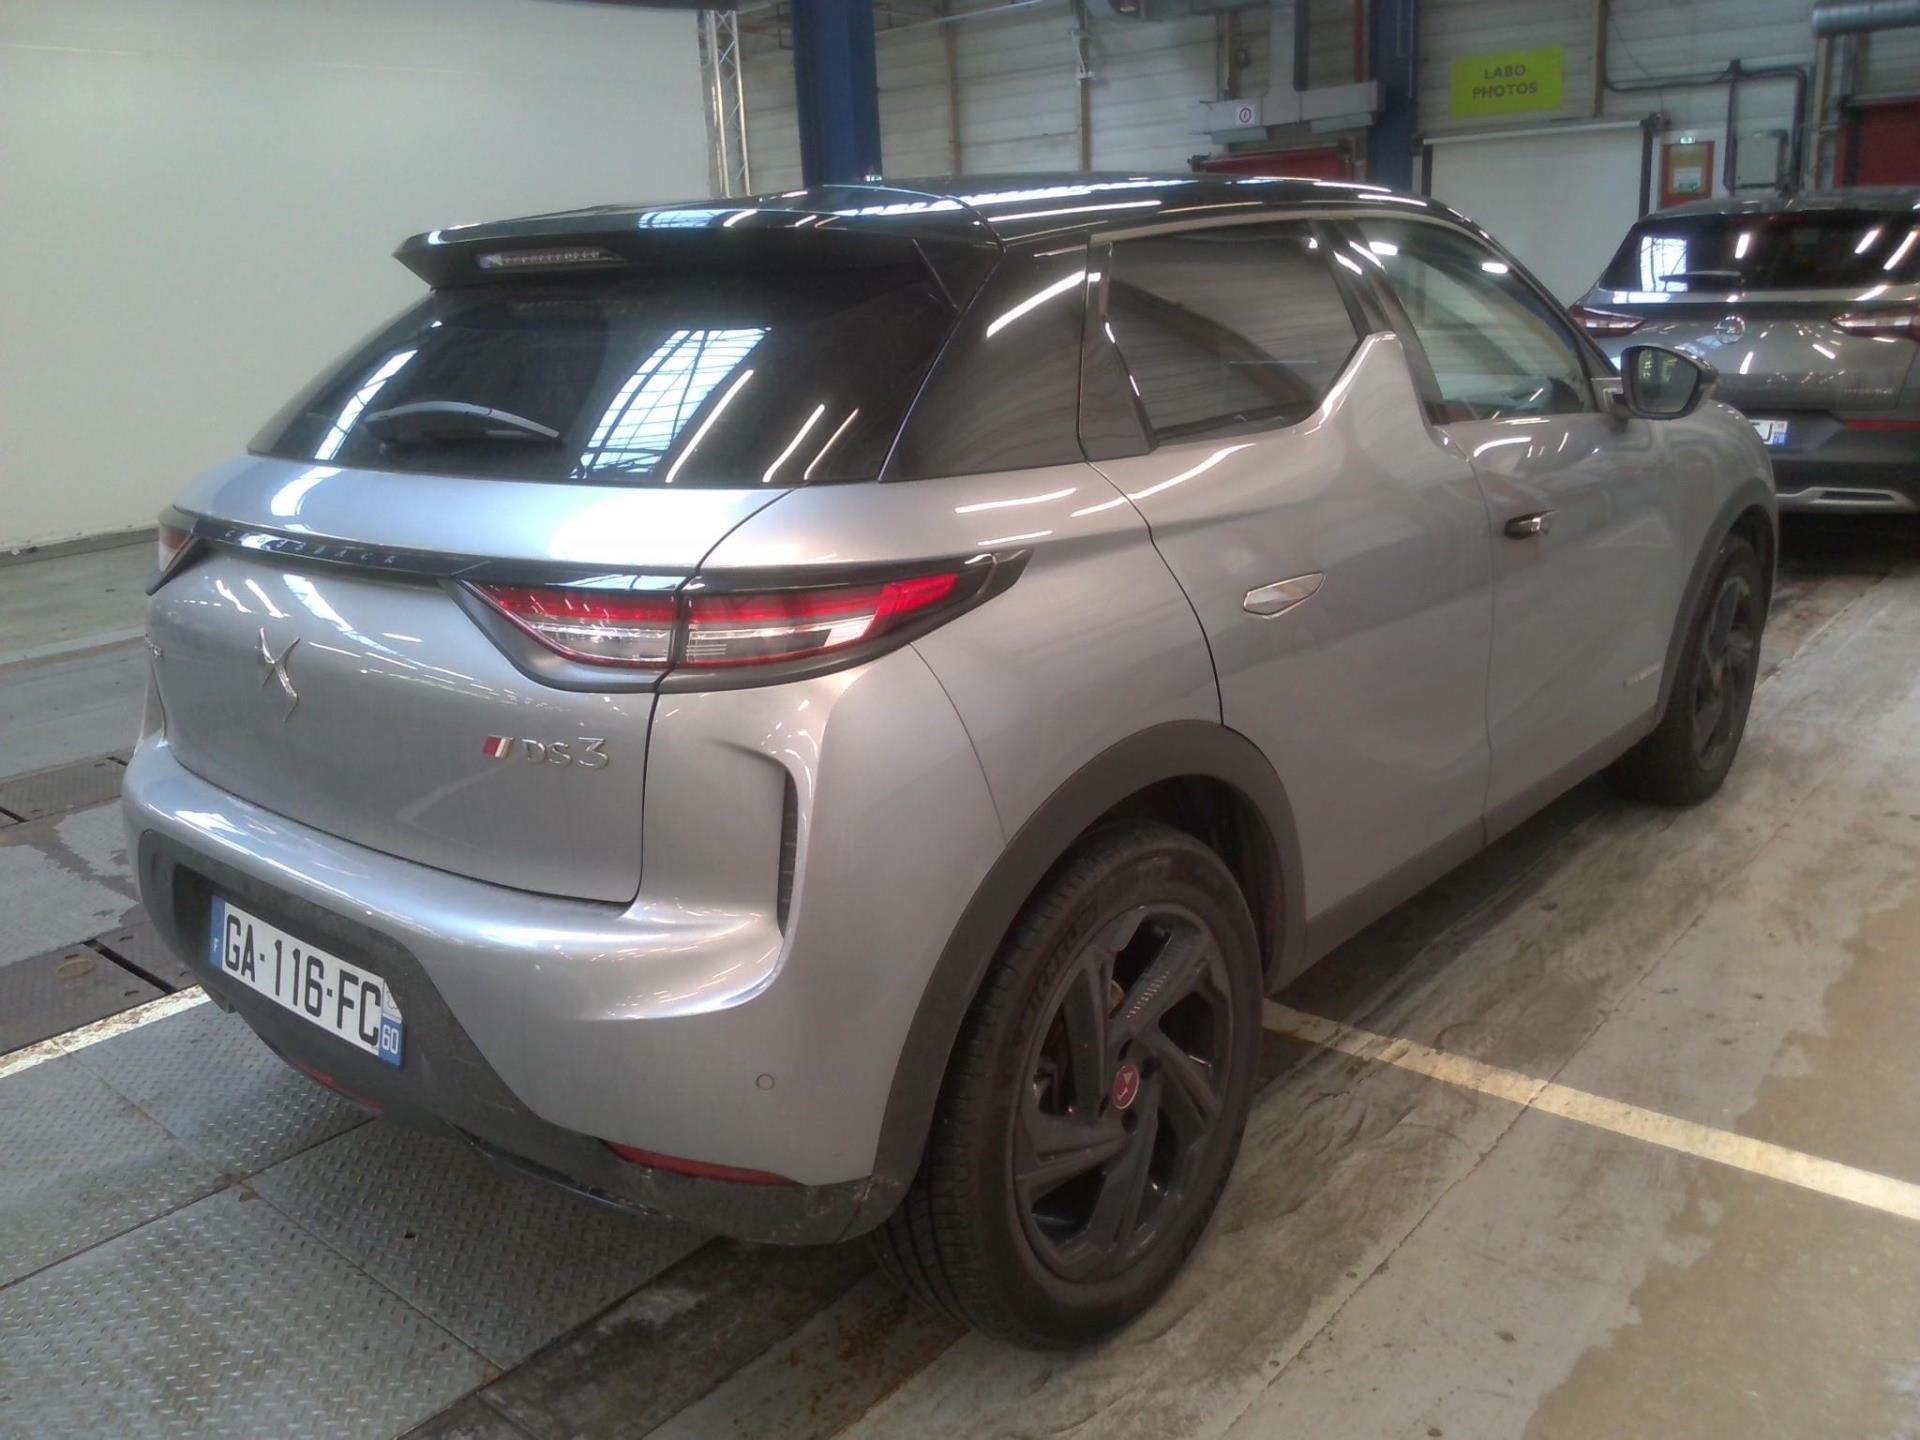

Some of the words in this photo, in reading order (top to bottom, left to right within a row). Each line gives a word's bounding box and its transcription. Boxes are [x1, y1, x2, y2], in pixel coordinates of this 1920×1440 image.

[1483, 64, 1526, 80] LABO
[1472, 82, 1538, 100] PHOTOS
[225, 914, 382, 1047] GA-116-FC
[381, 1024, 400, 1055] 60
